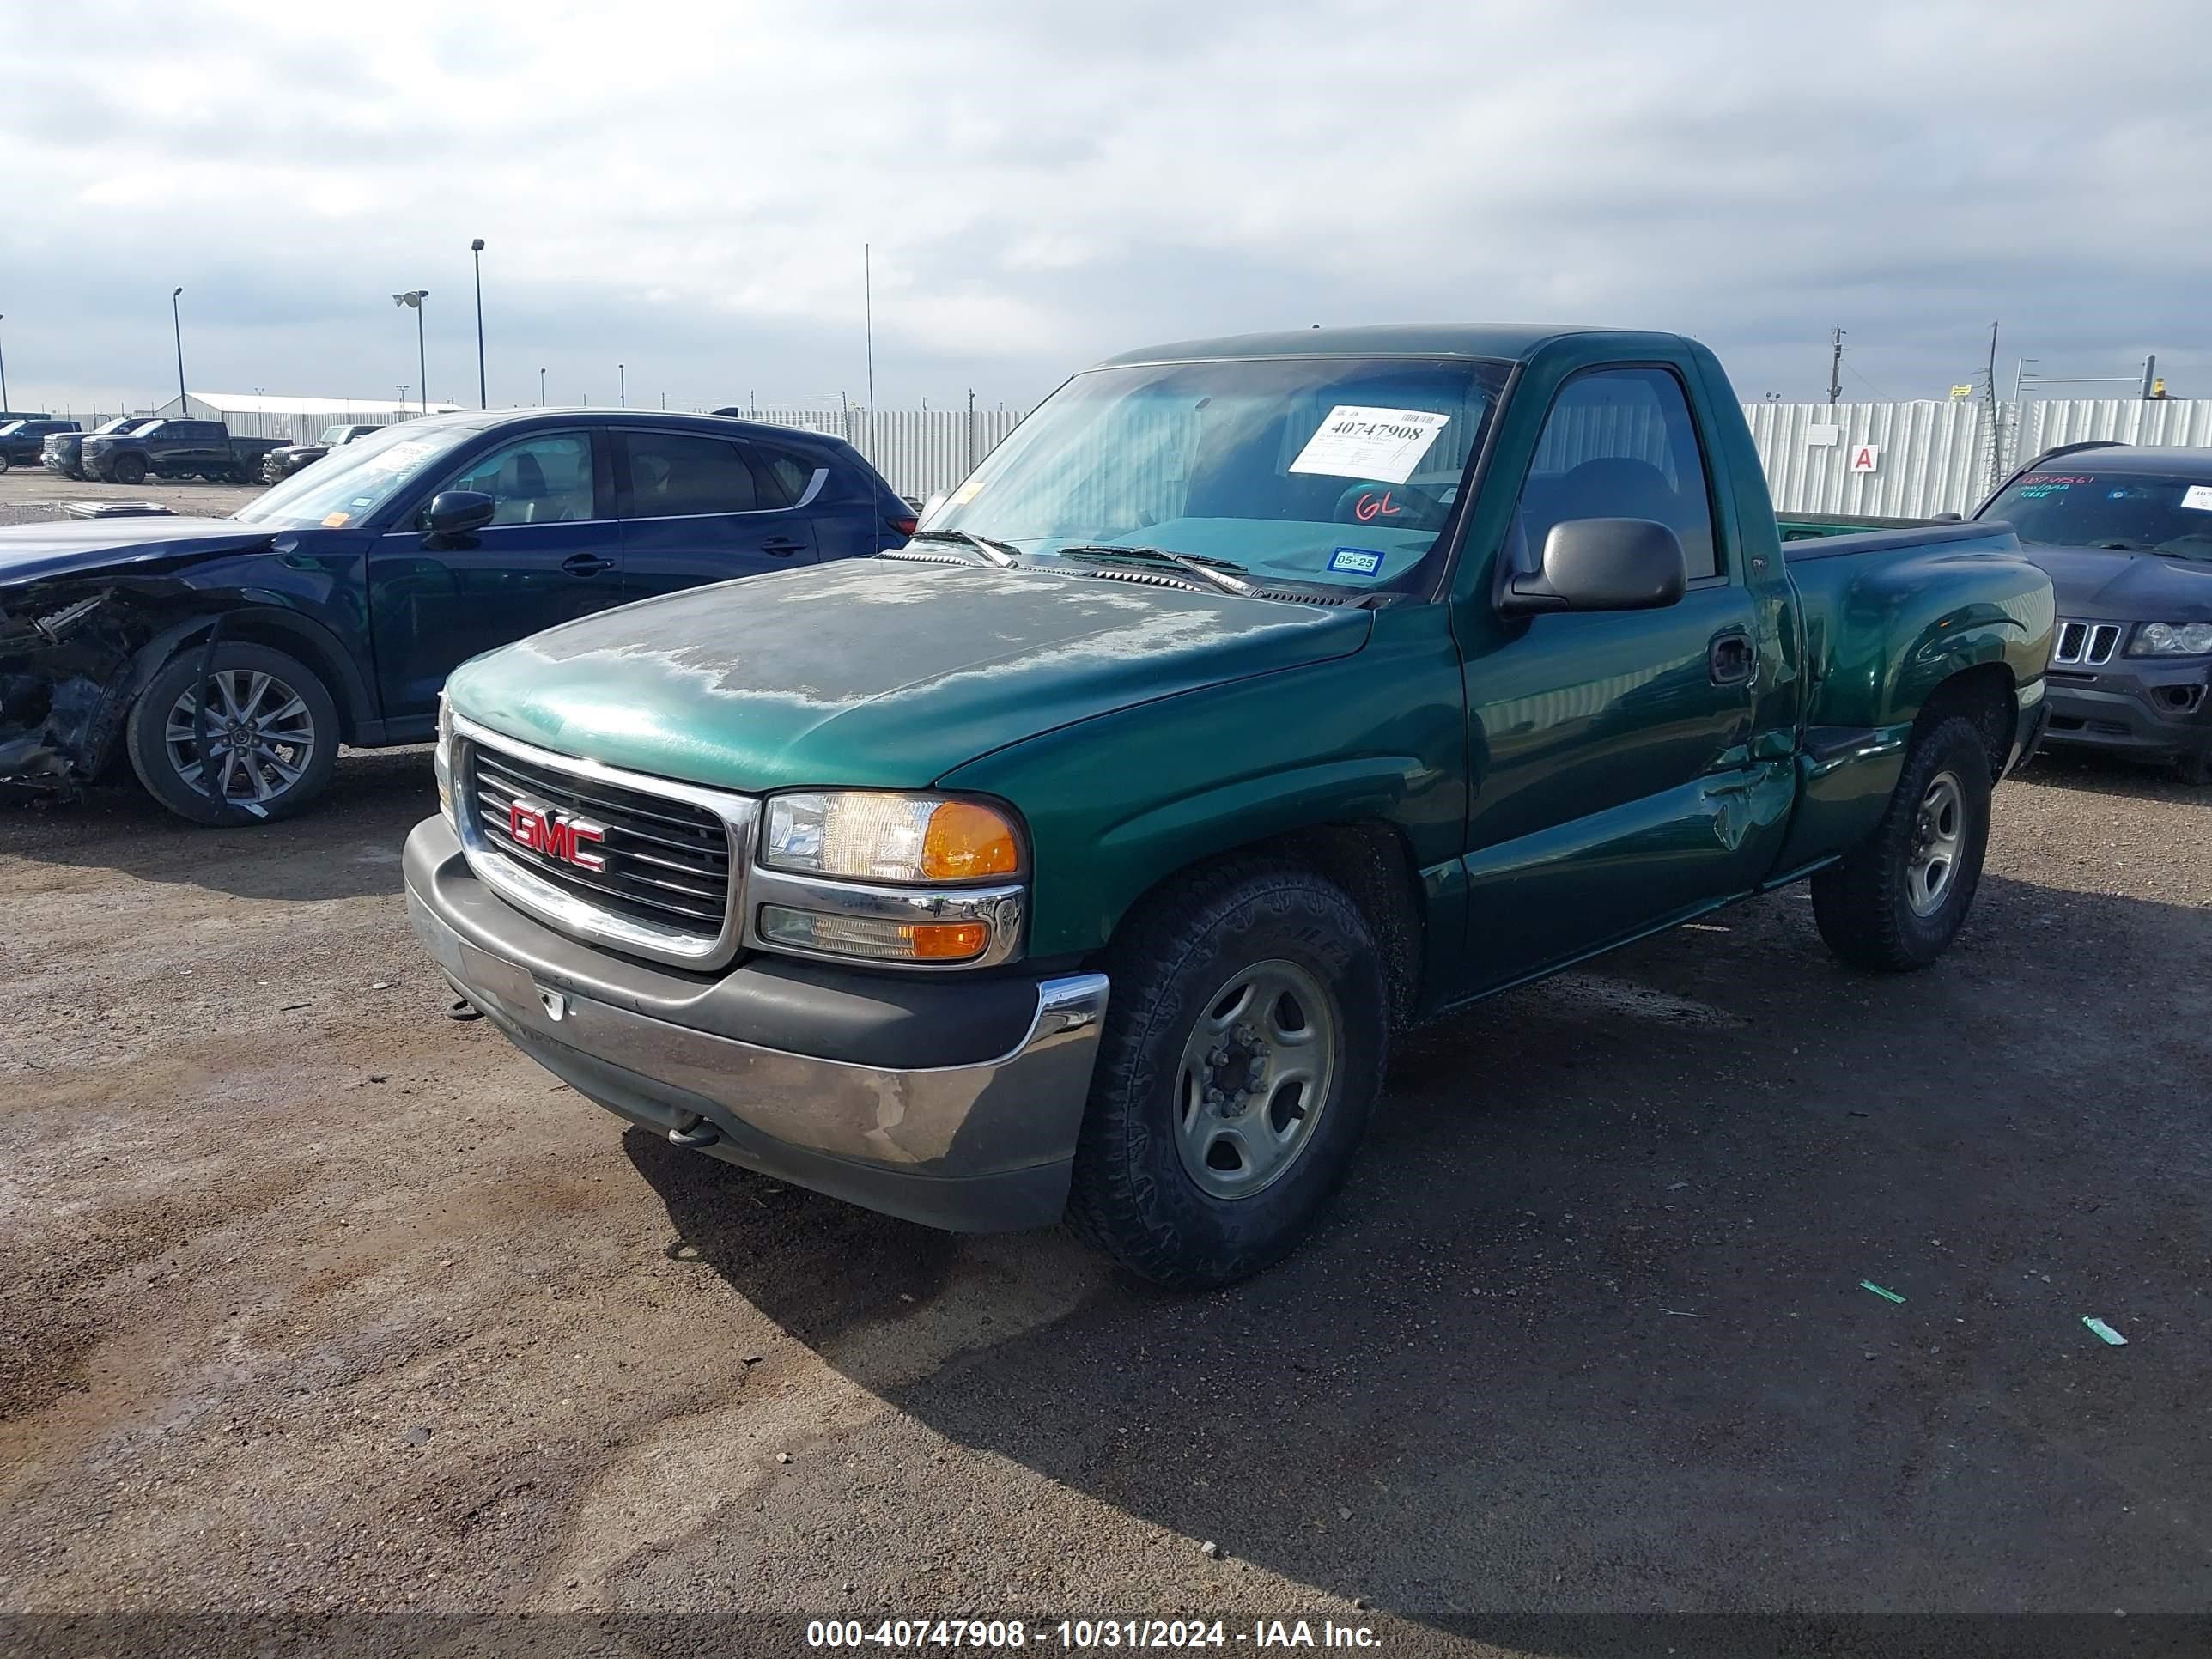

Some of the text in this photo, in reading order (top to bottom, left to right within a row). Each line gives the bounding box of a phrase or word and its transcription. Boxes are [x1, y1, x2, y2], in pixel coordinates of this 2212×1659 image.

[1331, 421, 1425, 441] 40747908
[1855, 448, 1872, 469] A
[510, 800, 606, 873] GMC
